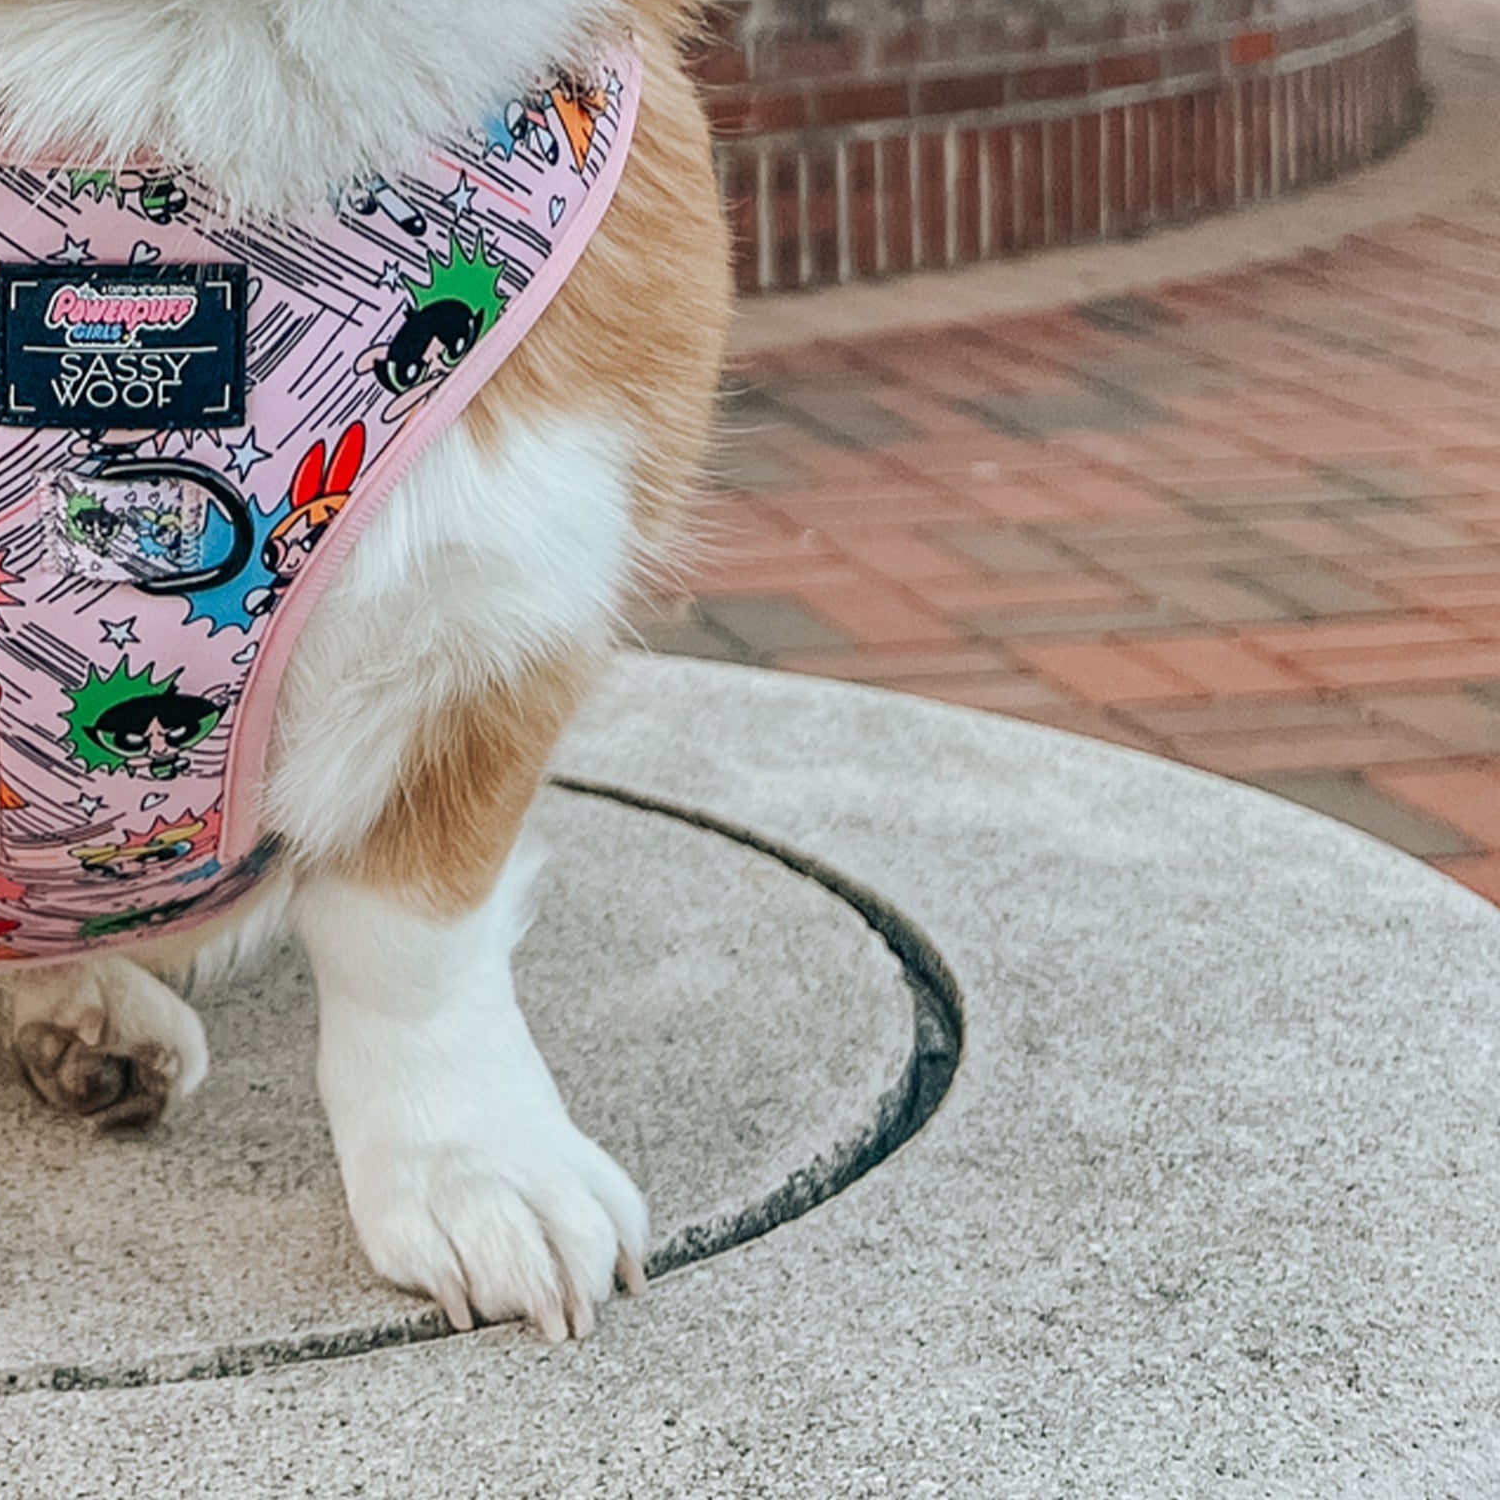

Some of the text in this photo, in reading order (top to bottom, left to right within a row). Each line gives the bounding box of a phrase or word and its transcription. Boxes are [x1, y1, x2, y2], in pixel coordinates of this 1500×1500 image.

[50, 288, 192, 331] POWERPUFF
[71, 322, 123, 341] GIRLS
[59, 353, 191, 383] SASSY
[50, 378, 182, 408] WOOF
